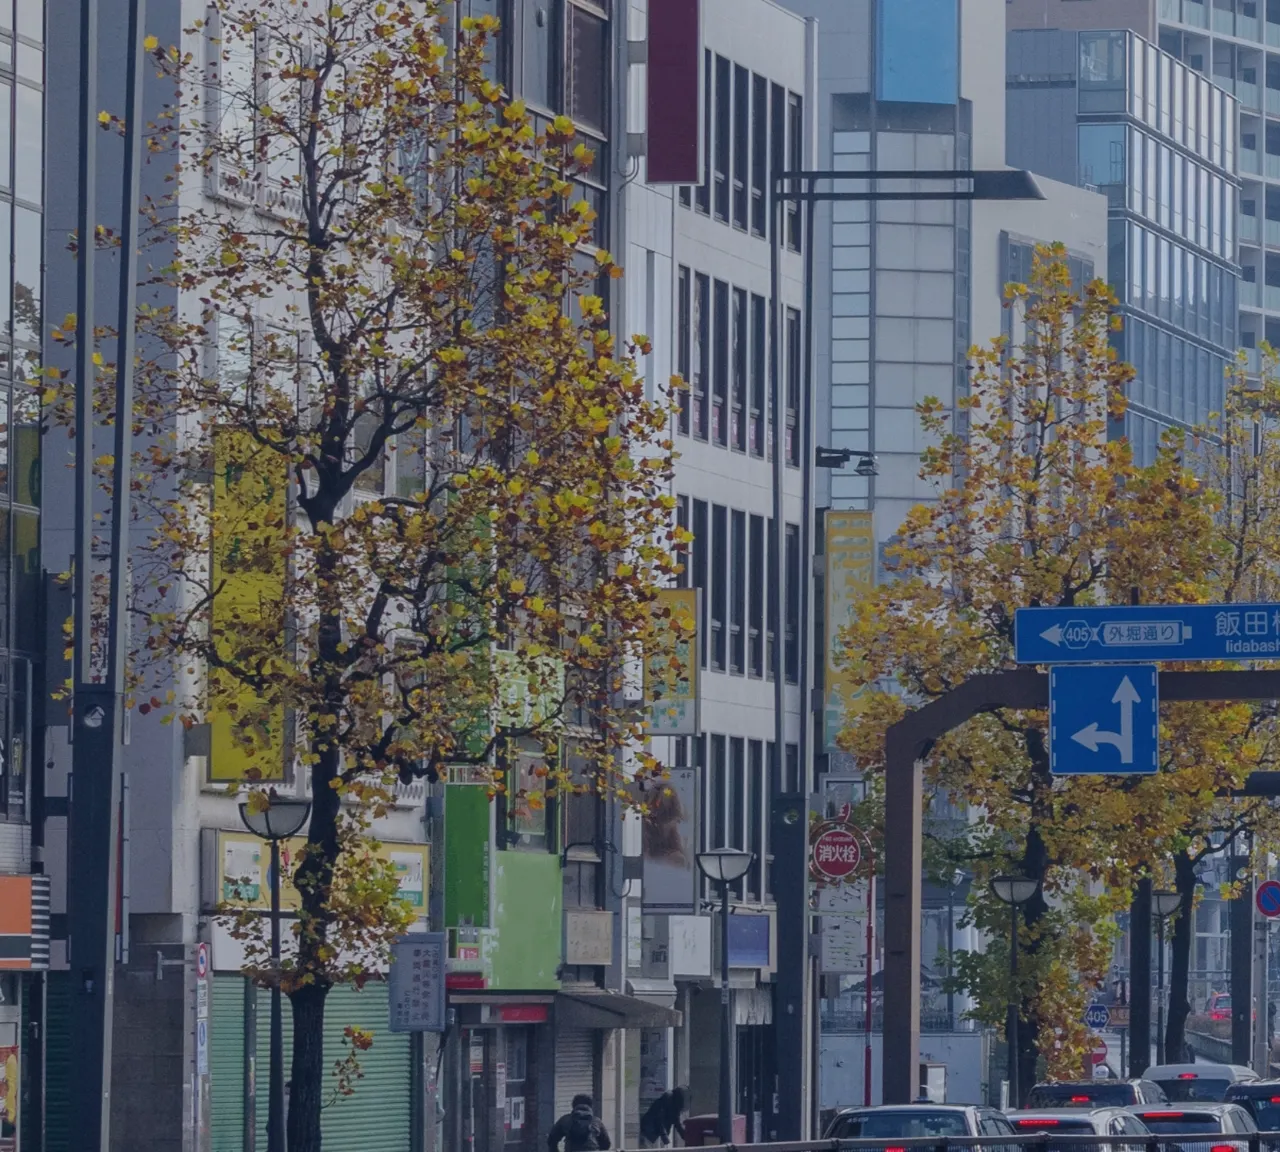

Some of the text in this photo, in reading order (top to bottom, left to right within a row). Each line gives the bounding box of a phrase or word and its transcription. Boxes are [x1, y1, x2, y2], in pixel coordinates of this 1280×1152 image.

[1065, 626, 1089, 642] 405
[1108, 625, 1175, 643] 外堀通り
[819, 844, 857, 863] 消火栓
[1087, 1010, 1107, 1023] 405
